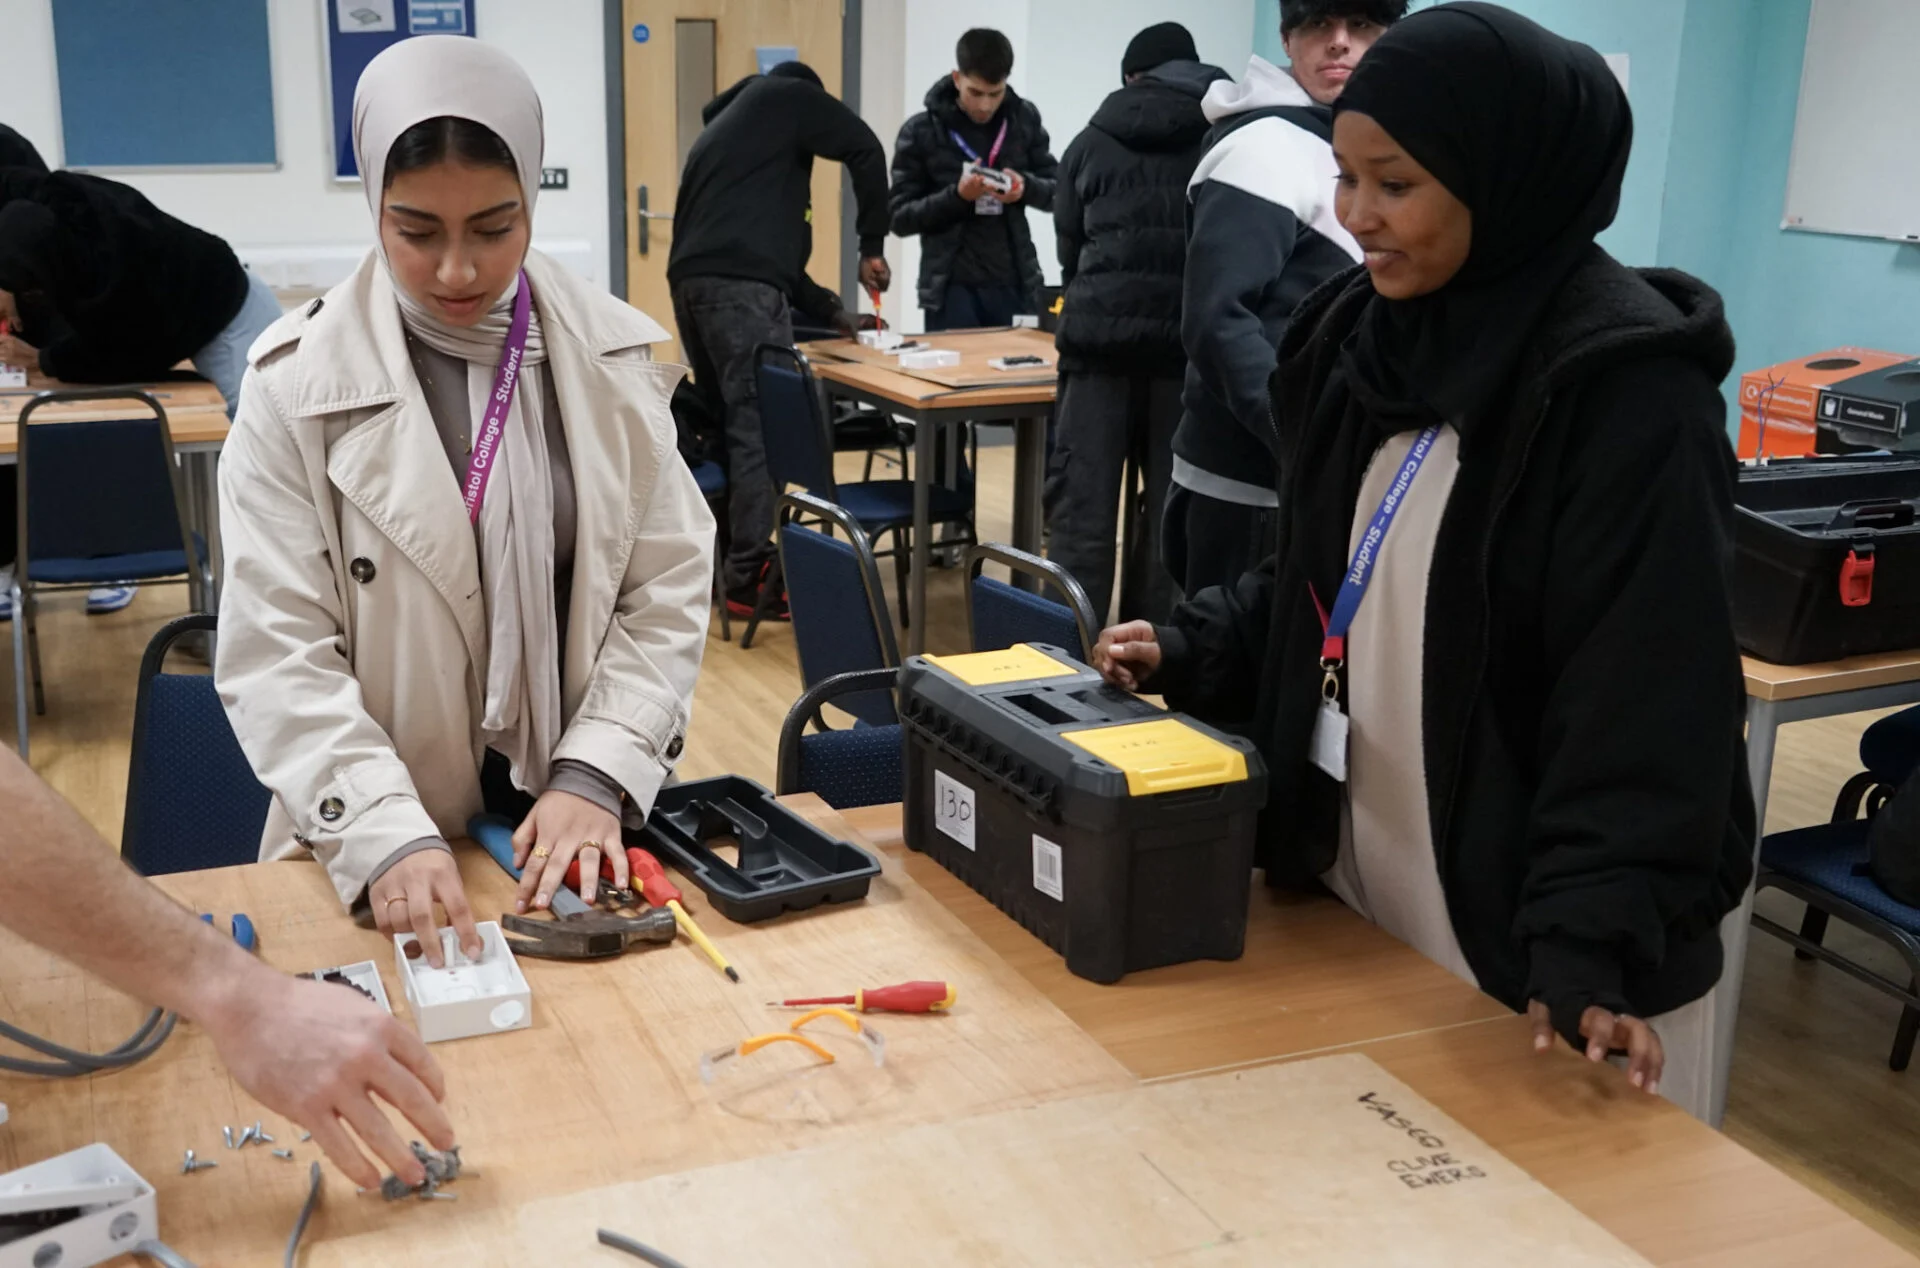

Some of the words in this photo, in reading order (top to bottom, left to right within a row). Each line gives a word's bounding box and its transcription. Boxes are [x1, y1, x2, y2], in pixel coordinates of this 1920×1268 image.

[474, 417, 499, 469] College
[495, 347, 521, 404] Student
[1413, 426, 1437, 459] istol
[1383, 460, 1417, 514] College
[1348, 526, 1381, 585] Student
[941, 783, 972, 821] 130
